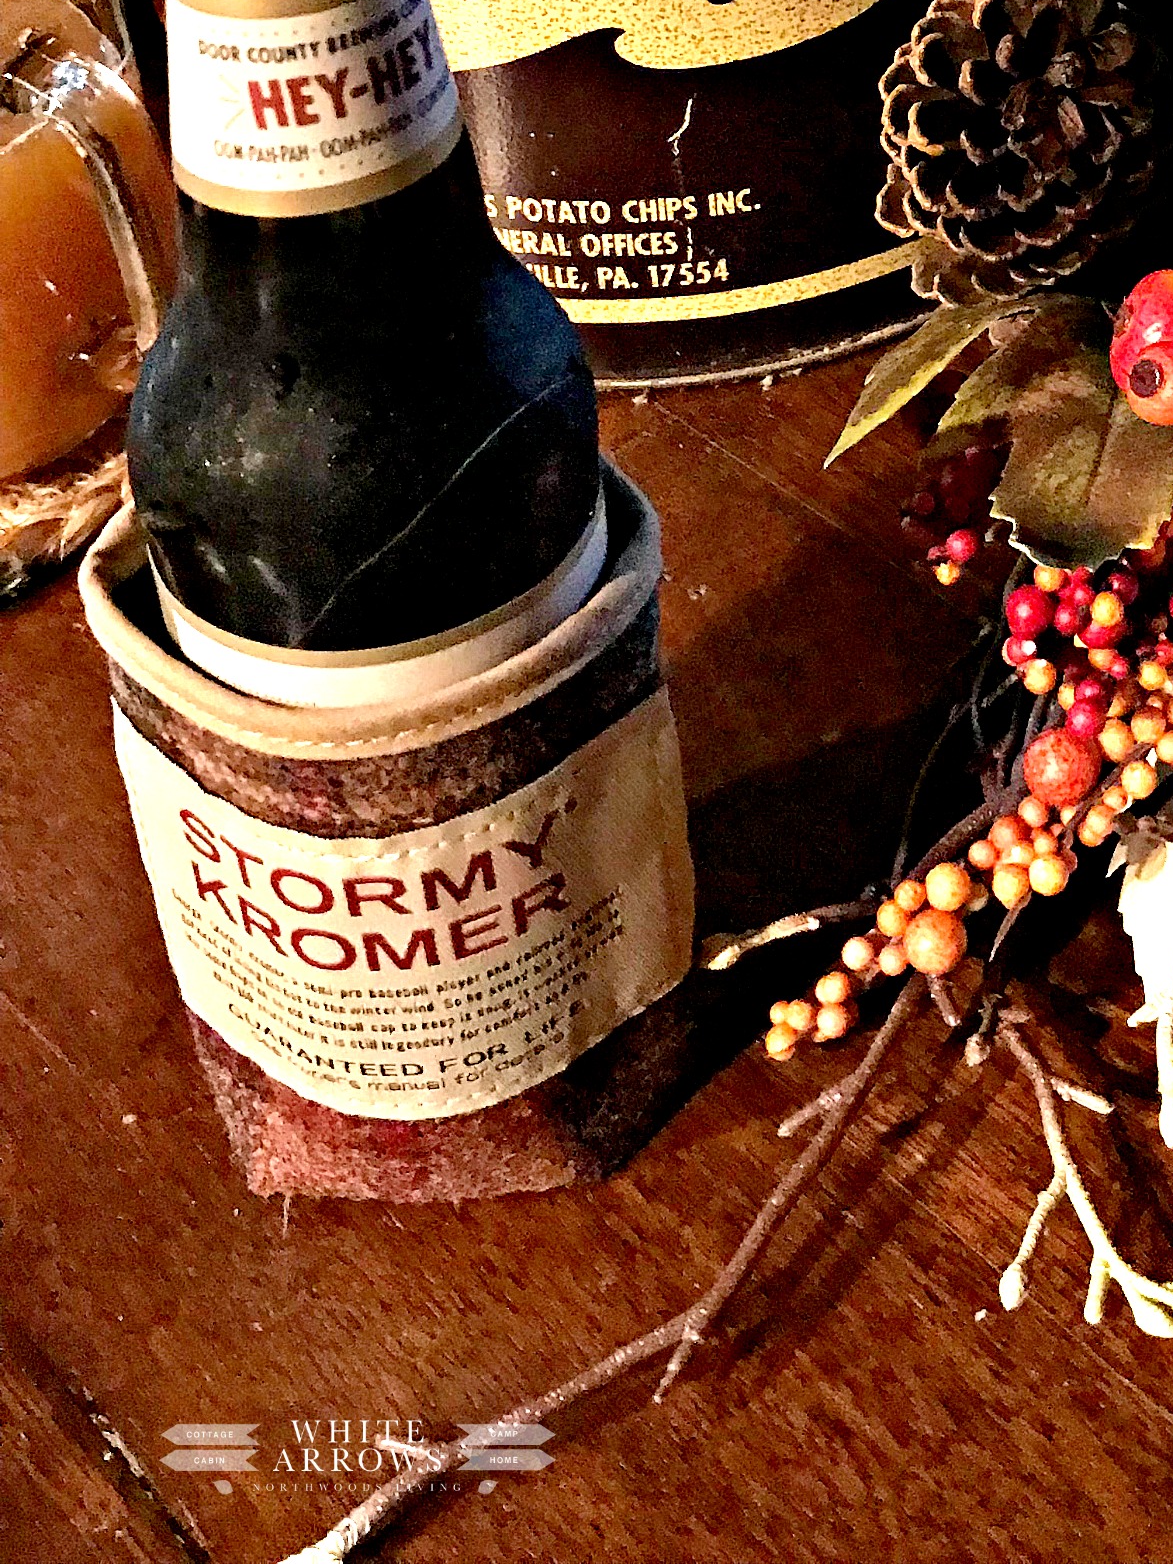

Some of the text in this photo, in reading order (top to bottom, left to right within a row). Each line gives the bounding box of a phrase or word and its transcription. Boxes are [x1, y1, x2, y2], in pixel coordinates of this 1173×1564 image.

[198, 40, 240, 62] DOOR
[247, 38, 321, 64] COUNTY
[247, 19, 434, 130] HEY-HEY
[507, 196, 611, 224] POTATO
[622, 196, 698, 224] CHIPS
[708, 188, 762, 217] INC.
[493, 227, 678, 258] NERAL OFFICES
[597, 266, 639, 290] PA.
[647, 259, 730, 287] 17554
[179, 796, 578, 917] STORMY
[190, 861, 571, 973] KROMER
[228, 1003, 424, 1077] GUARANTEED
[439, 1043, 509, 1073] FOR
[454, 1070, 488, 1084] for
